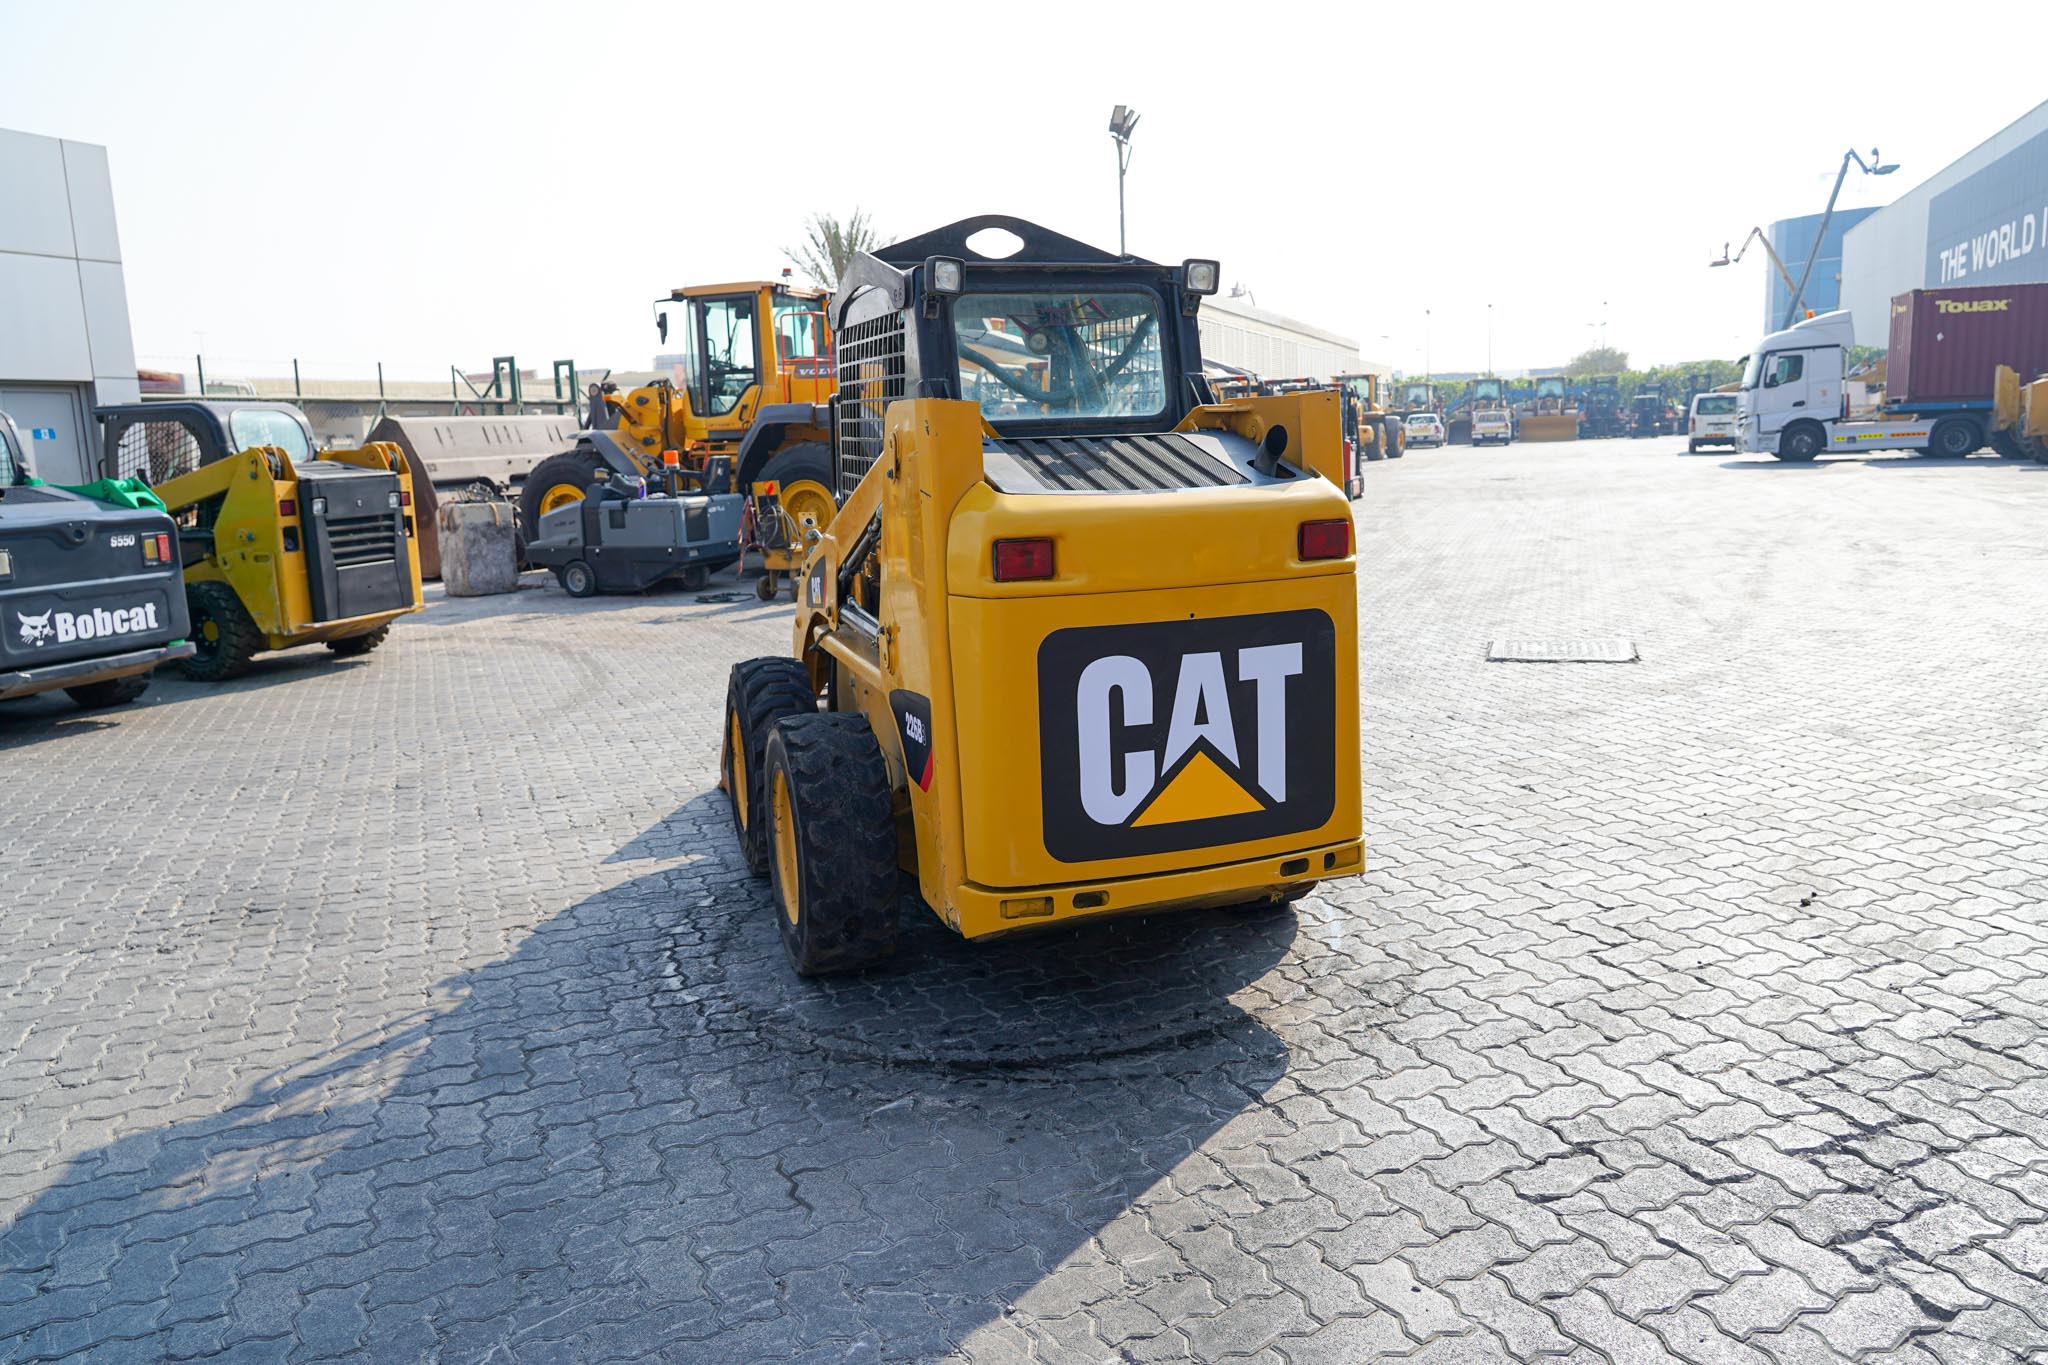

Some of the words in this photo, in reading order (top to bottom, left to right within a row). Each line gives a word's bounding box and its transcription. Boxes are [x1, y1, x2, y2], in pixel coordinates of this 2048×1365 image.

[1940, 241, 1969, 284] THE
[1972, 213, 2036, 273] WORLD
[1935, 298, 2009, 314] Touax
[110, 534, 136, 548] S550
[54, 602, 159, 644] Bobcat
[1077, 642, 1303, 827] CAT
